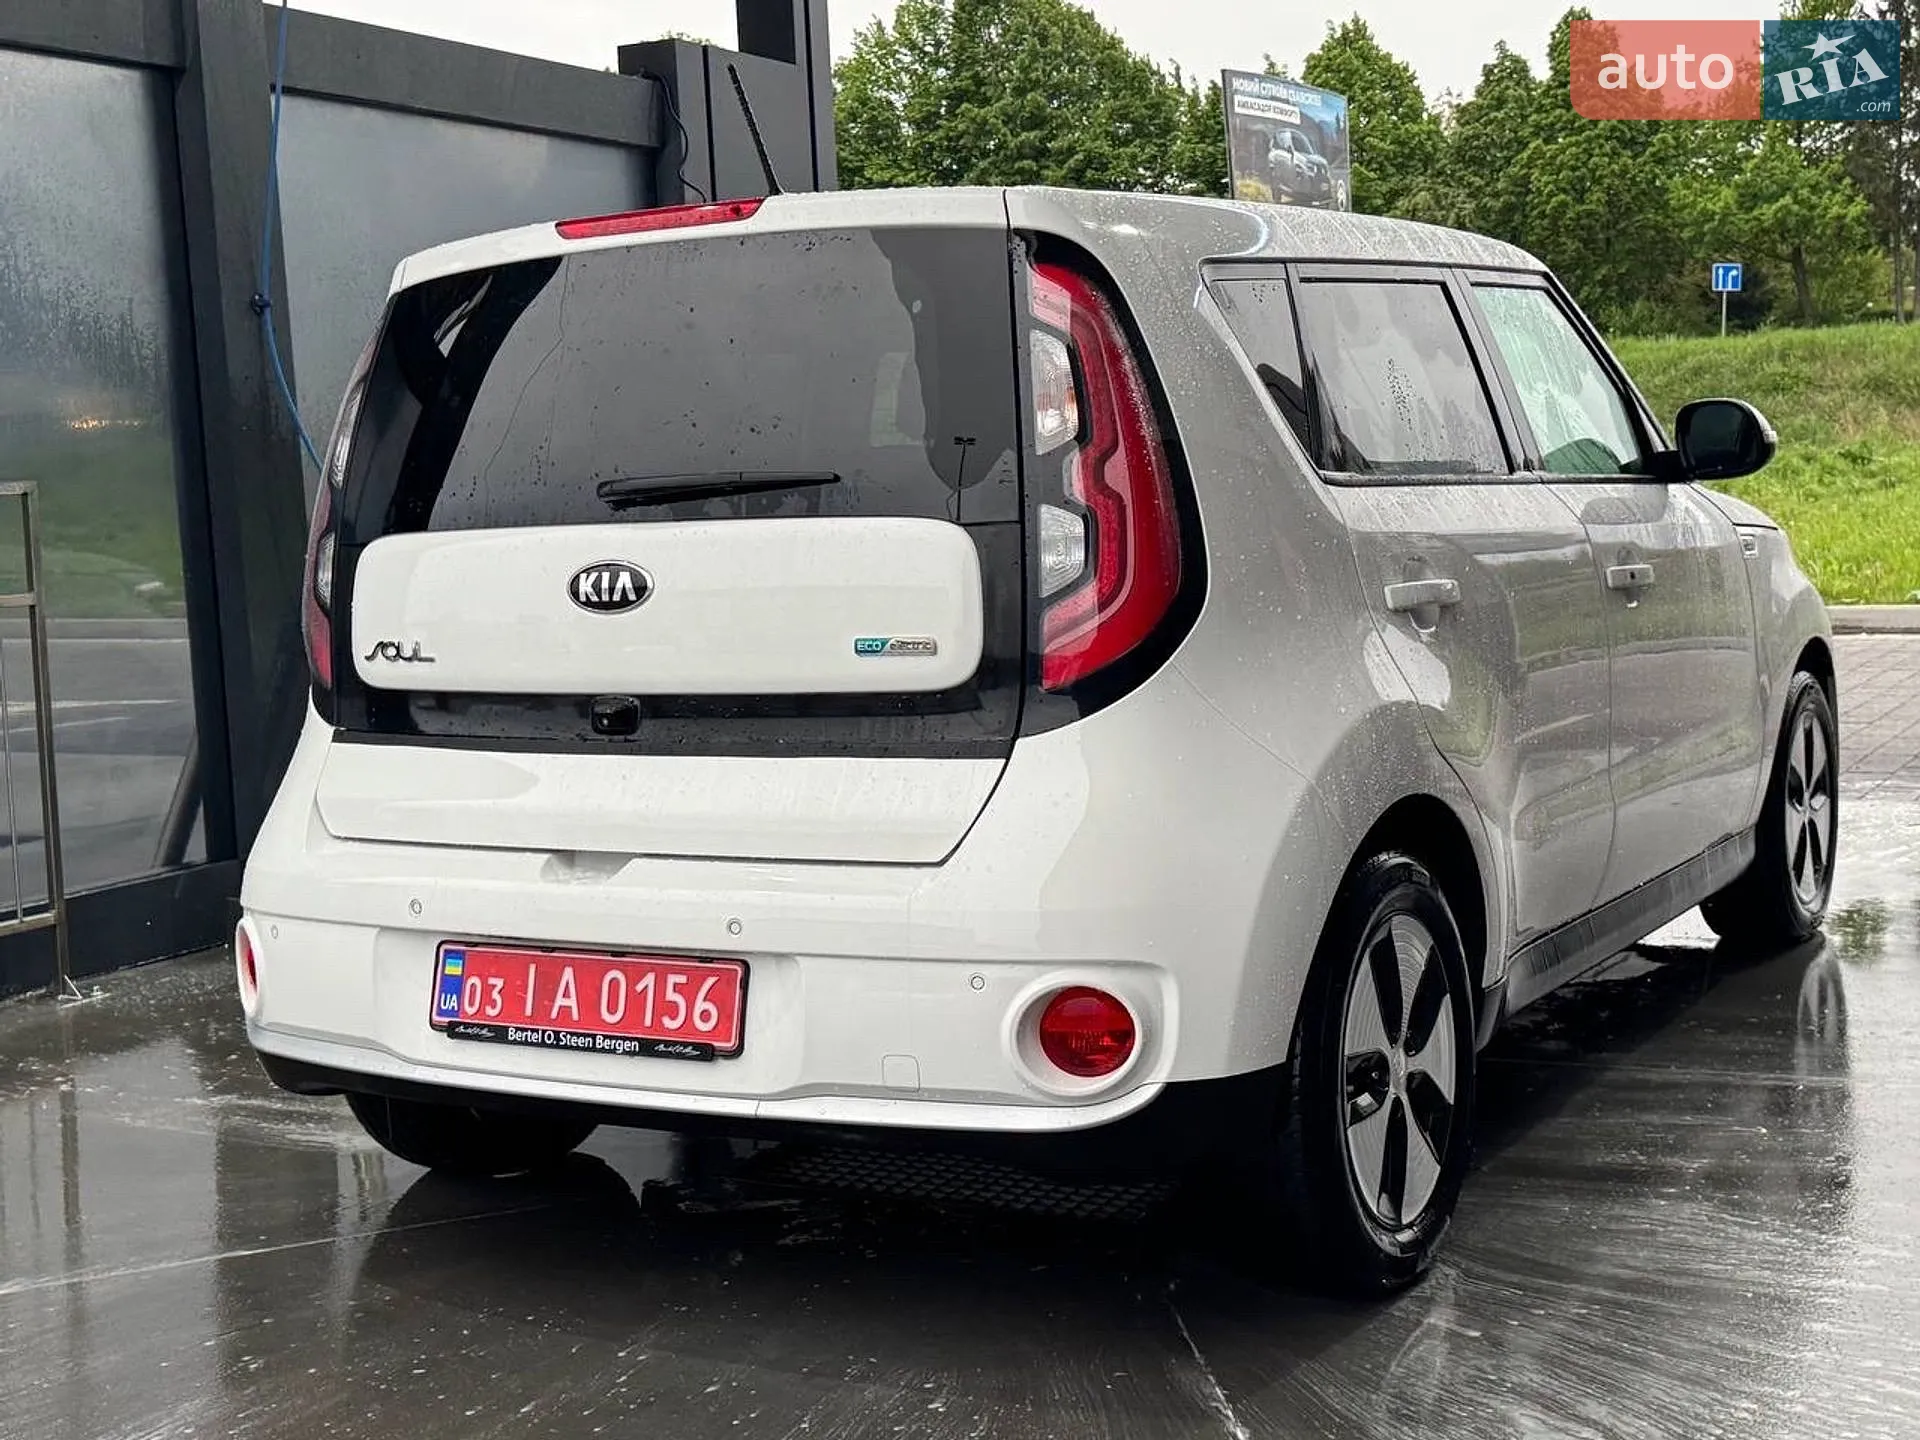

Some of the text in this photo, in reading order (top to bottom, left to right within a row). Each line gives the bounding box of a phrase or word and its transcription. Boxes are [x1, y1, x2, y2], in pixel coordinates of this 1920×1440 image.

[578, 571, 638, 602] KIA
[856, 640, 882, 651] ECO
[440, 994, 458, 1011] UA
[463, 975, 506, 1017] 03
[600, 969, 721, 1033] 0156
[508, 1027, 542, 1043] Bertel
[544, 1030, 557, 1045] O.
[559, 1032, 593, 1049] Steen
[595, 1035, 639, 1054] Bergen
